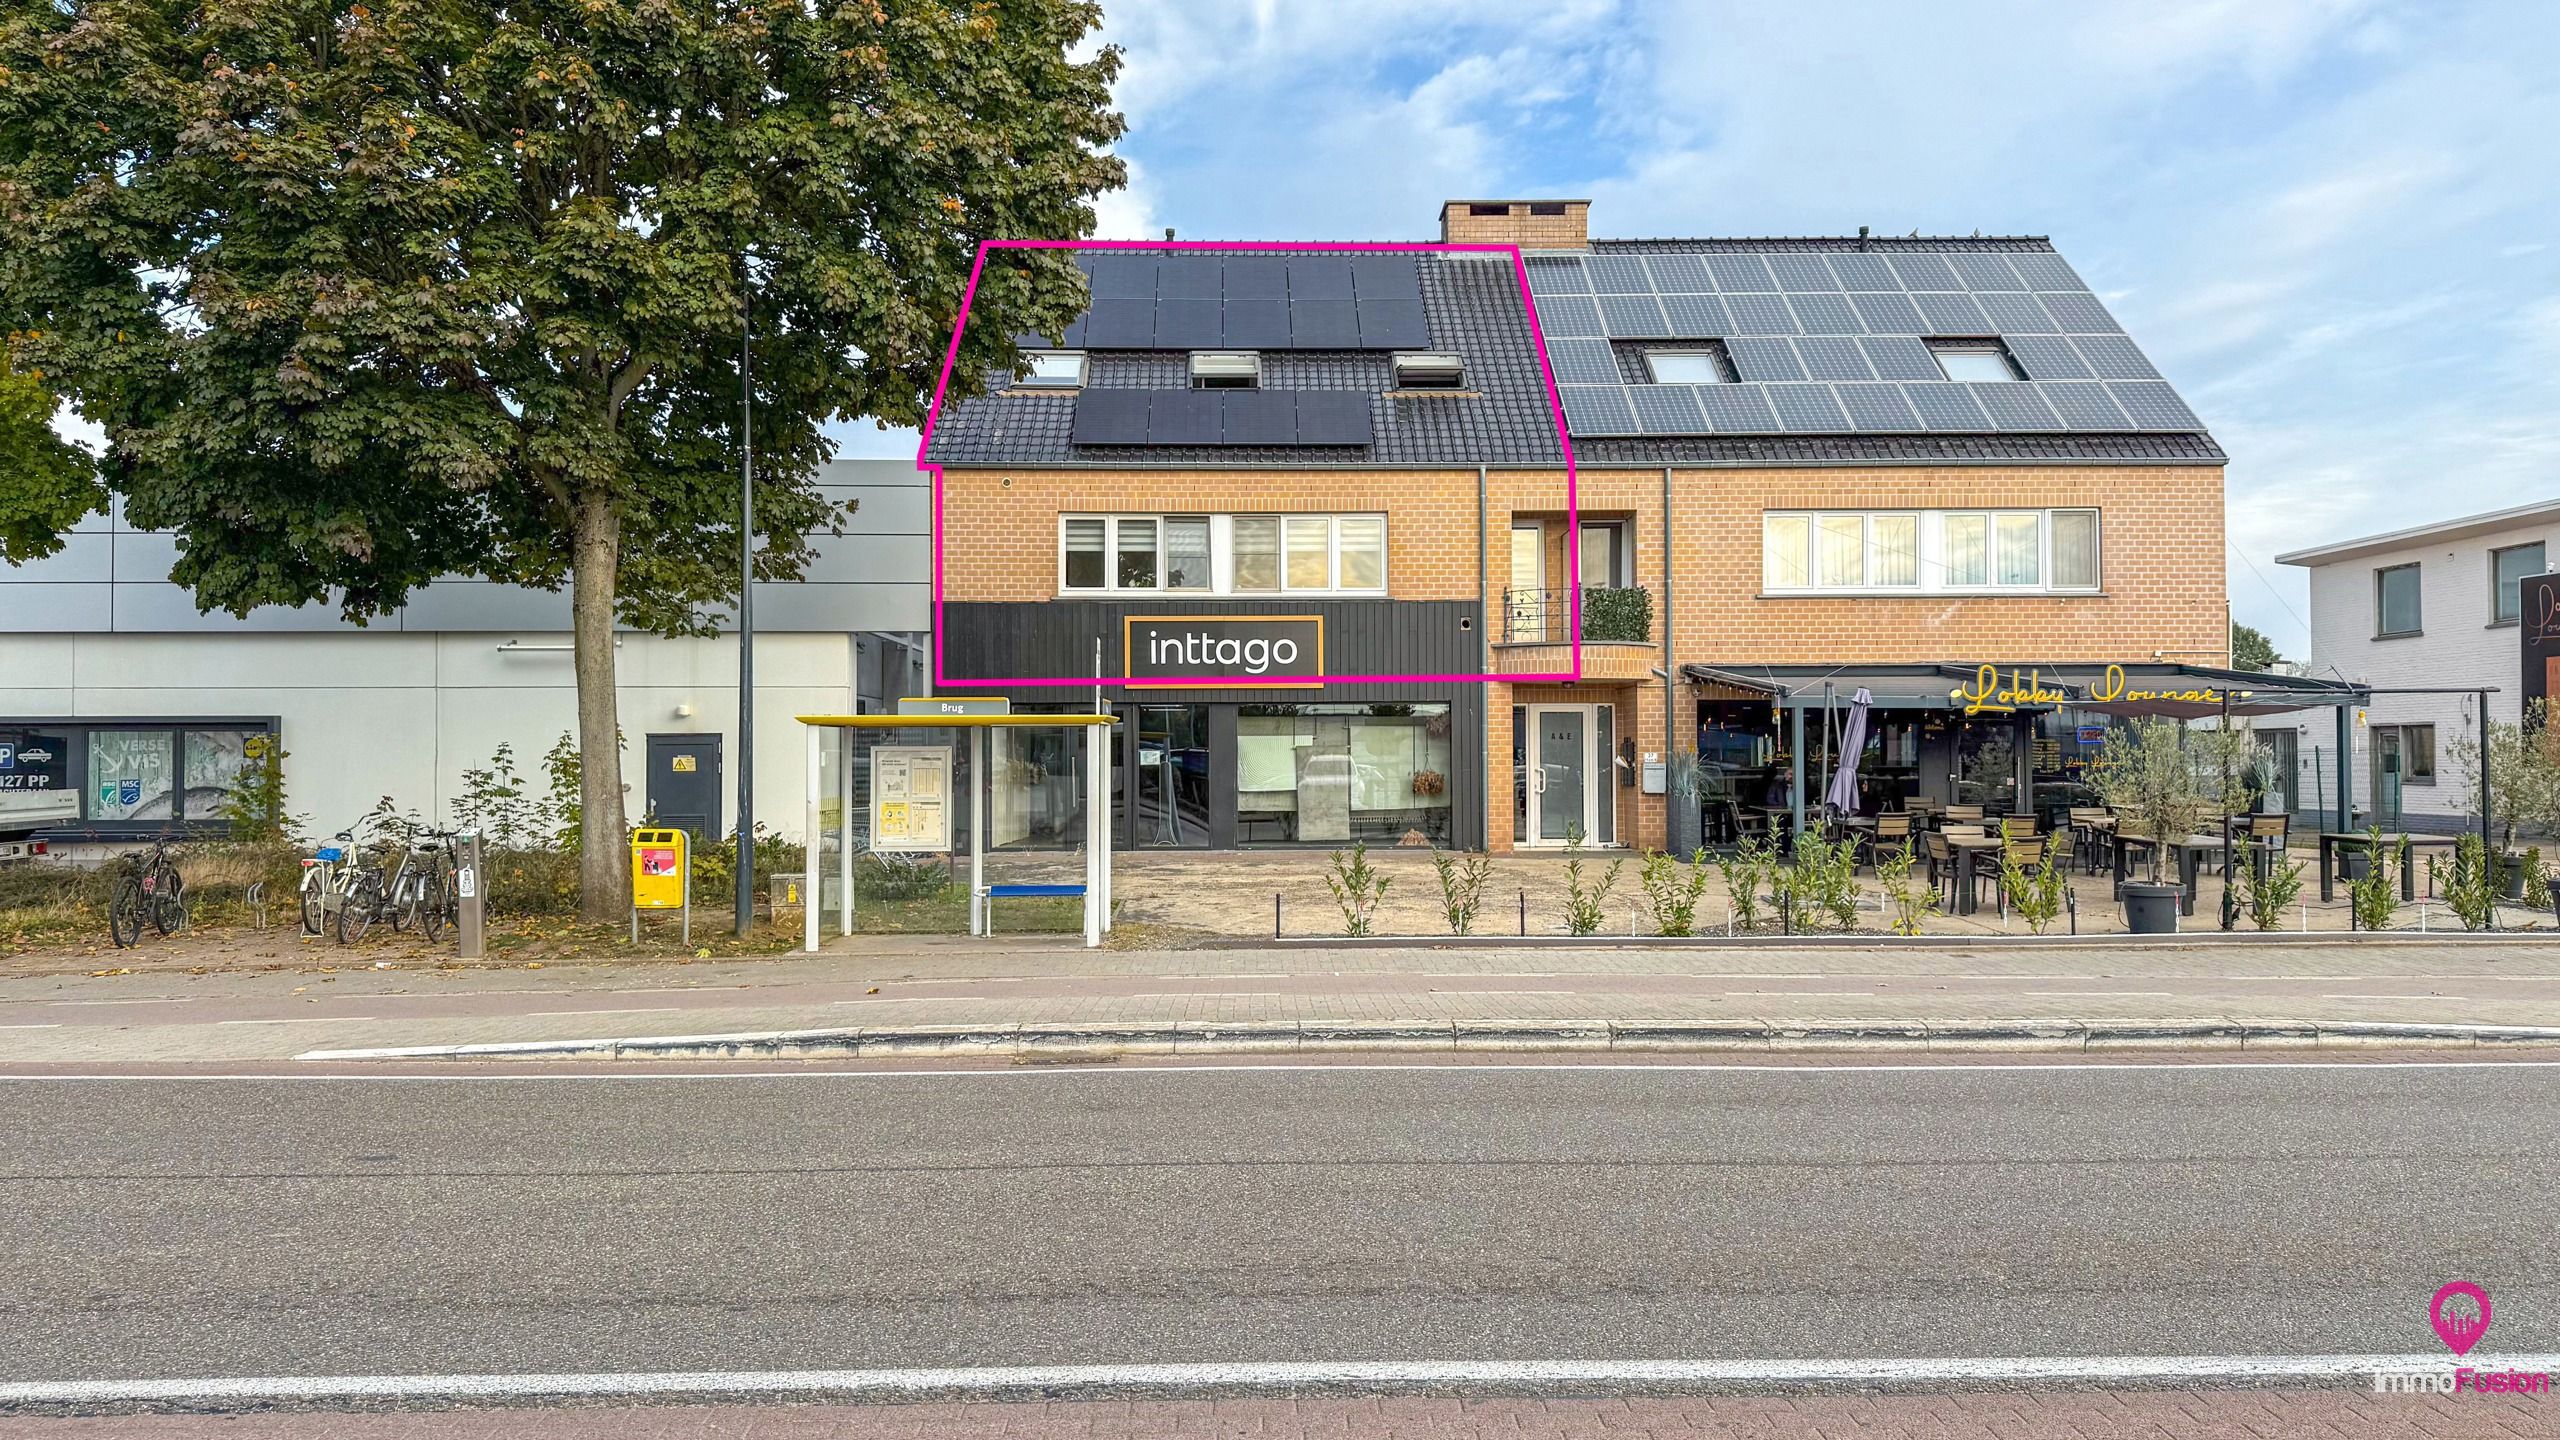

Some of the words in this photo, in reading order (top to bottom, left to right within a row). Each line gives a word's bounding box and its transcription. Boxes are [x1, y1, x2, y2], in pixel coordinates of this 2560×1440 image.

[1150, 631, 1298, 674] inttago
[1961, 664, 2065, 715] Lobby
[941, 703, 964, 714] Brug
[120, 739, 165, 751] VERSE
[127, 752, 160, 769] VIS
[28, 775, 49, 787] PP
